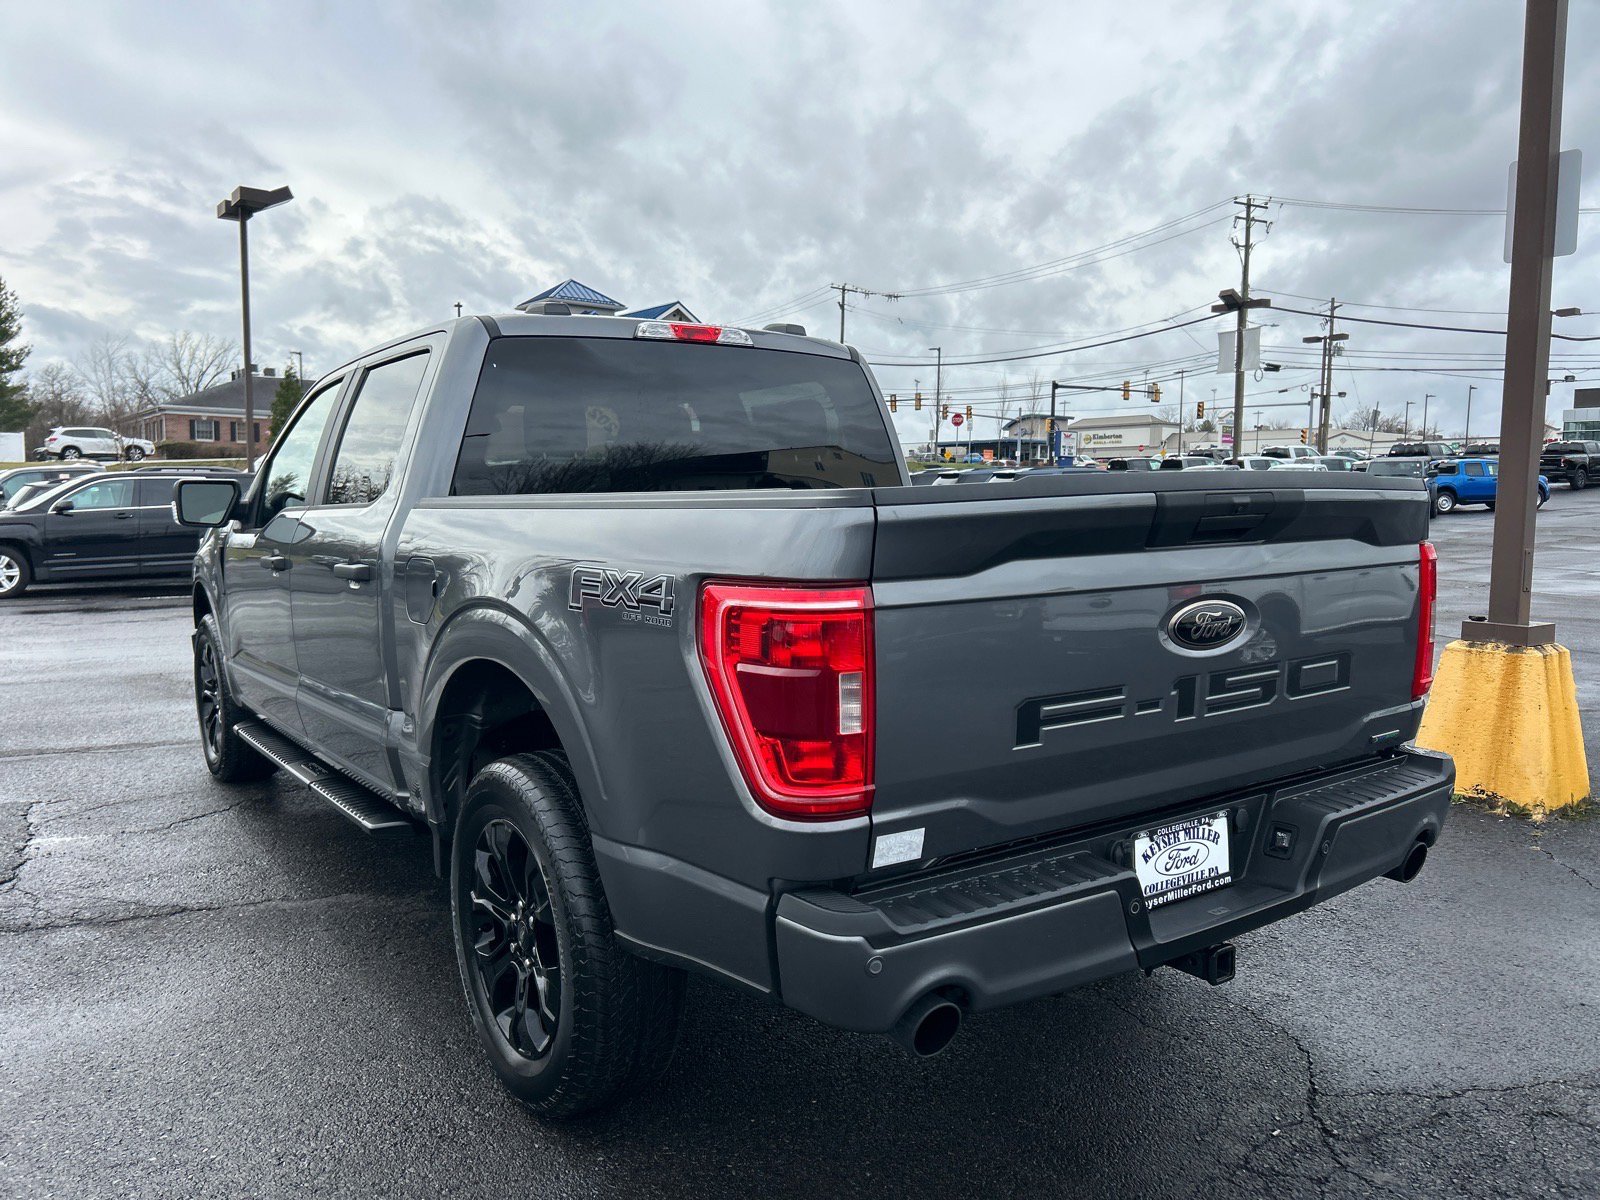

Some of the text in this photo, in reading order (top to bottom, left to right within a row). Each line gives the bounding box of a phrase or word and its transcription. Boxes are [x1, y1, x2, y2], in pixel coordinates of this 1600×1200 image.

[567, 565, 676, 617] FX4
[622, 611, 673, 628] OFF ROAD
[1190, 611, 1233, 640] Ford
[1012, 650, 1353, 752] F-150
[1141, 827, 1221, 864] KEYSER MILLER
[1164, 846, 1200, 872] Ford
